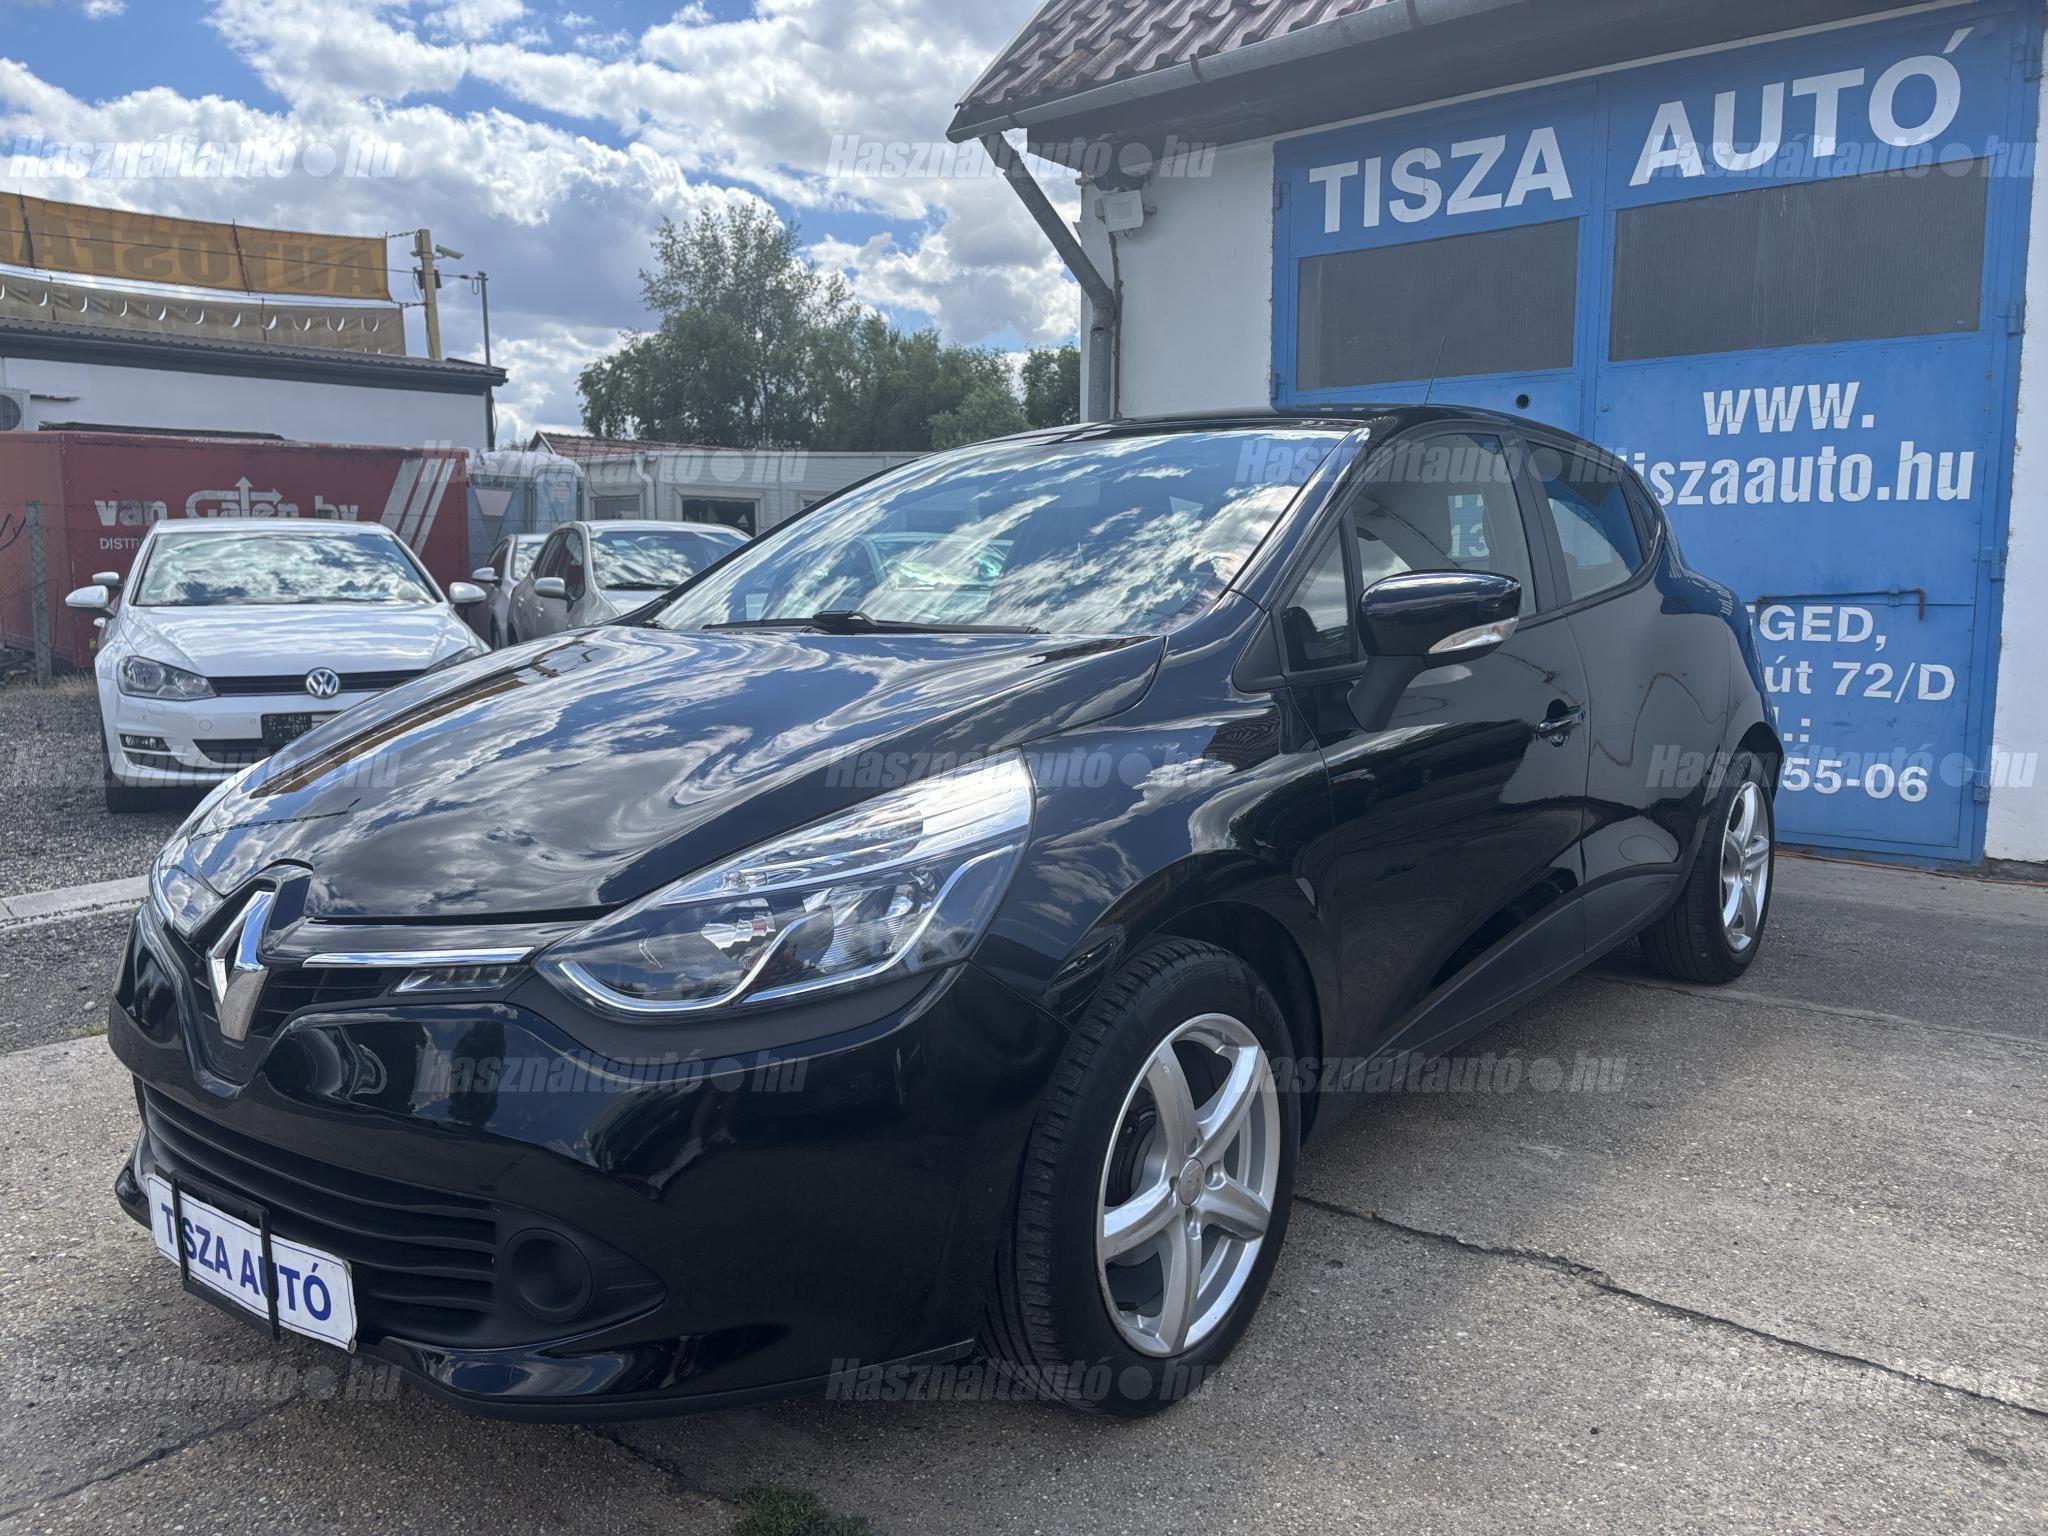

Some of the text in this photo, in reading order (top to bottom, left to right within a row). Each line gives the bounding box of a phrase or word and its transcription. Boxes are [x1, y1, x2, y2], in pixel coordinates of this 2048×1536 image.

[1309, 27, 1973, 233] TISZA AUTÓ
[1703, 381, 1875, 436] www.
[1618, 441, 1974, 505] iszaauto.hu
[95, 498, 168, 527] van
[100, 536, 153, 551] DISTR
[1832, 662, 1955, 703] 72/D
[161, 1202, 233, 1281] TSZA
